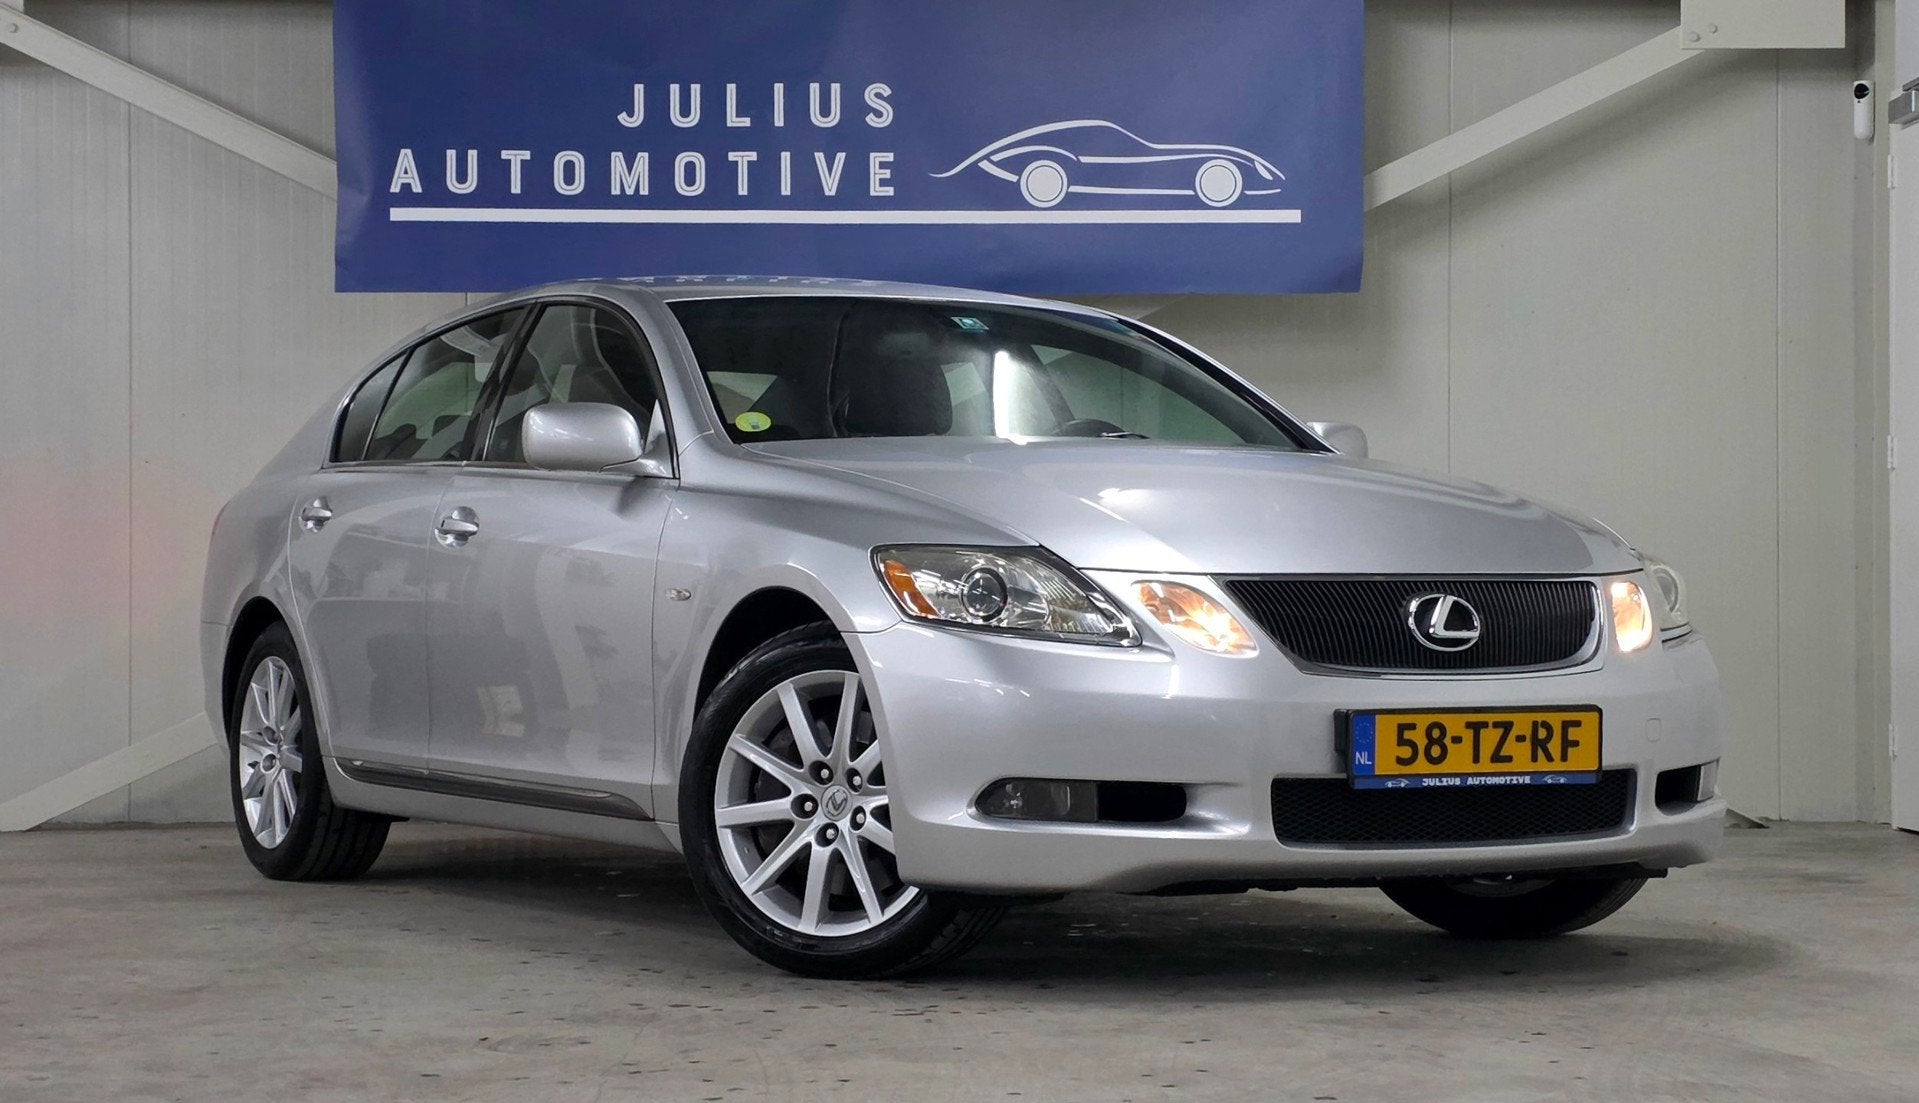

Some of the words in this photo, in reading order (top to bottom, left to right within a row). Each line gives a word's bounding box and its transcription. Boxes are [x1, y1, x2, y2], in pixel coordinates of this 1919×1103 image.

[617, 82, 894, 128] JULIUS
[389, 148, 895, 197] AUTOMOTIVE
[1355, 751, 1373, 765] NL
[1395, 719, 1583, 767] 58-TZ-RF
[1421, 777, 1461, 787] JULIUS
[1466, 775, 1531, 785] AUTOMOTIVE
